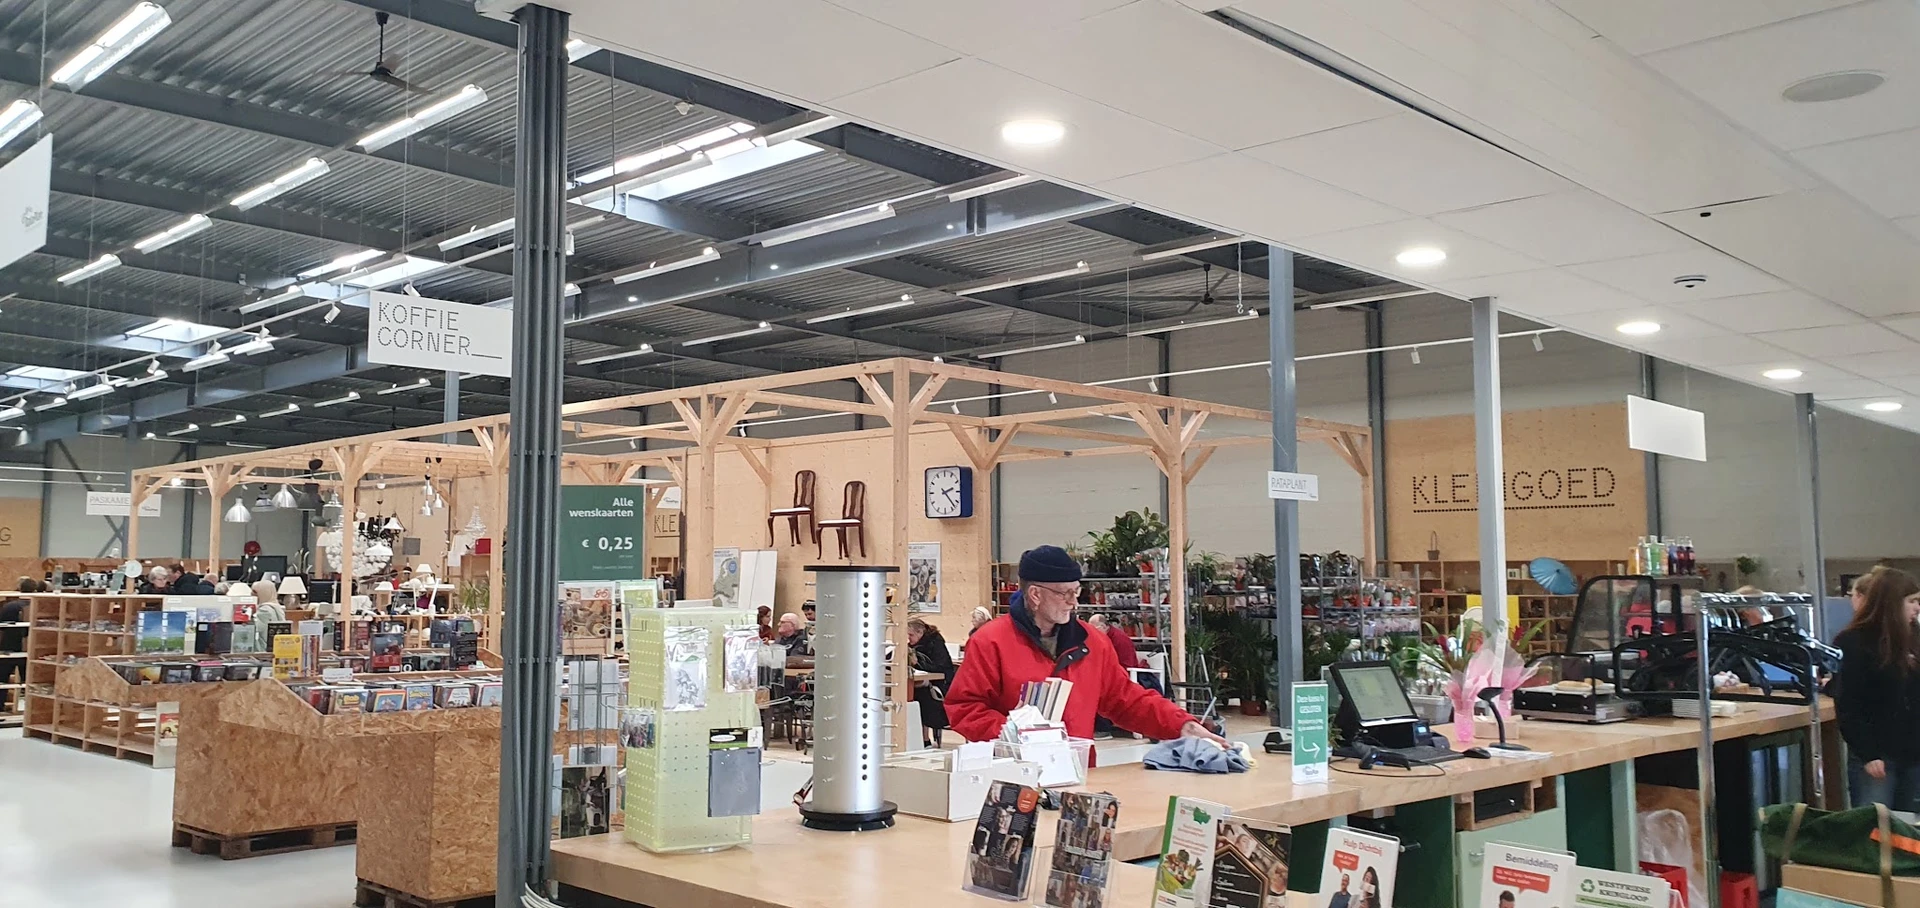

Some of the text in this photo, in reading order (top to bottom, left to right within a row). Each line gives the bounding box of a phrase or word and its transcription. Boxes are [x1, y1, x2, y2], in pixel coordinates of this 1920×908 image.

[378, 302, 459, 331] KOFFIE
[1412, 467, 1615, 504] KLEIGOED
[89, 496, 131, 504] PASKAME
[612, 498, 634, 507] Alle
[568, 508, 634, 518] wenskaarten
[653, 513, 681, 533] KLE
[581, 536, 634, 552] € 0,25
[1505, 852, 1559, 873] Bemiddeling
[1597, 879, 1652, 895] WESTFRIESE
